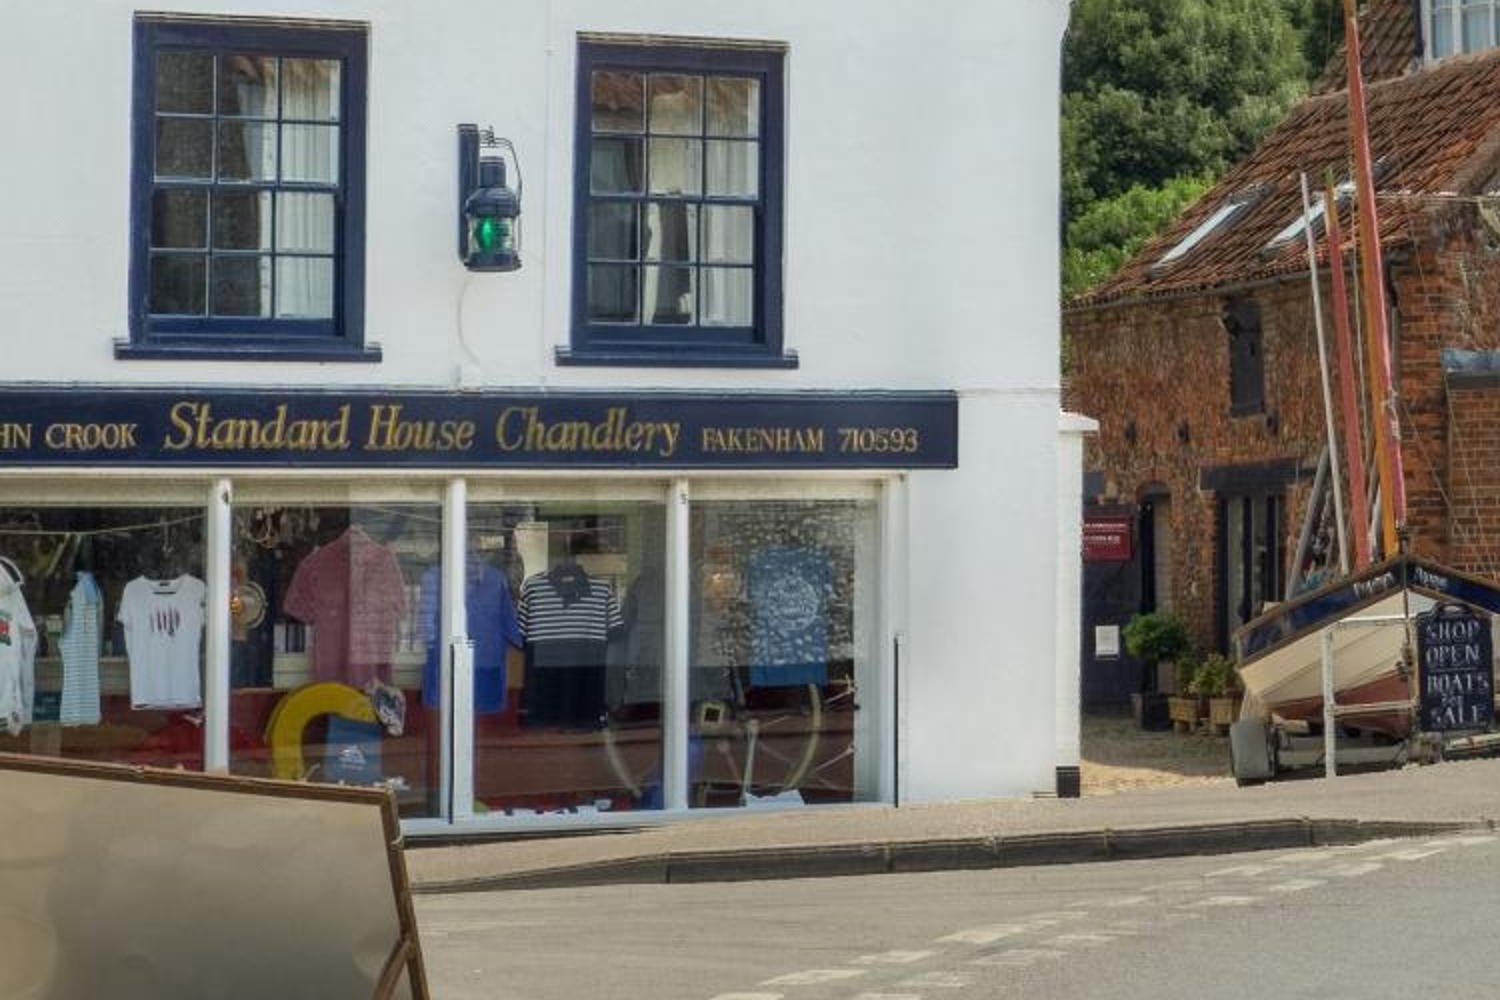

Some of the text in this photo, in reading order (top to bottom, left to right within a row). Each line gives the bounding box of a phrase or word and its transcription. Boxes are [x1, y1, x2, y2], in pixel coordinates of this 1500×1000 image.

[45, 423, 138, 450] CROOK
[161, 400, 351, 450] Standard
[363, 404, 476, 450] House
[496, 406, 681, 457] Chandlery
[703, 427, 824, 452] FAKENHAM
[837, 427, 919, 453] 710593
[1426, 621, 1480, 641] SHOP
[1425, 644, 1480, 664] OPEN
[1426, 672, 1490, 694] BOATS
[1430, 703, 1488, 727] SALE
